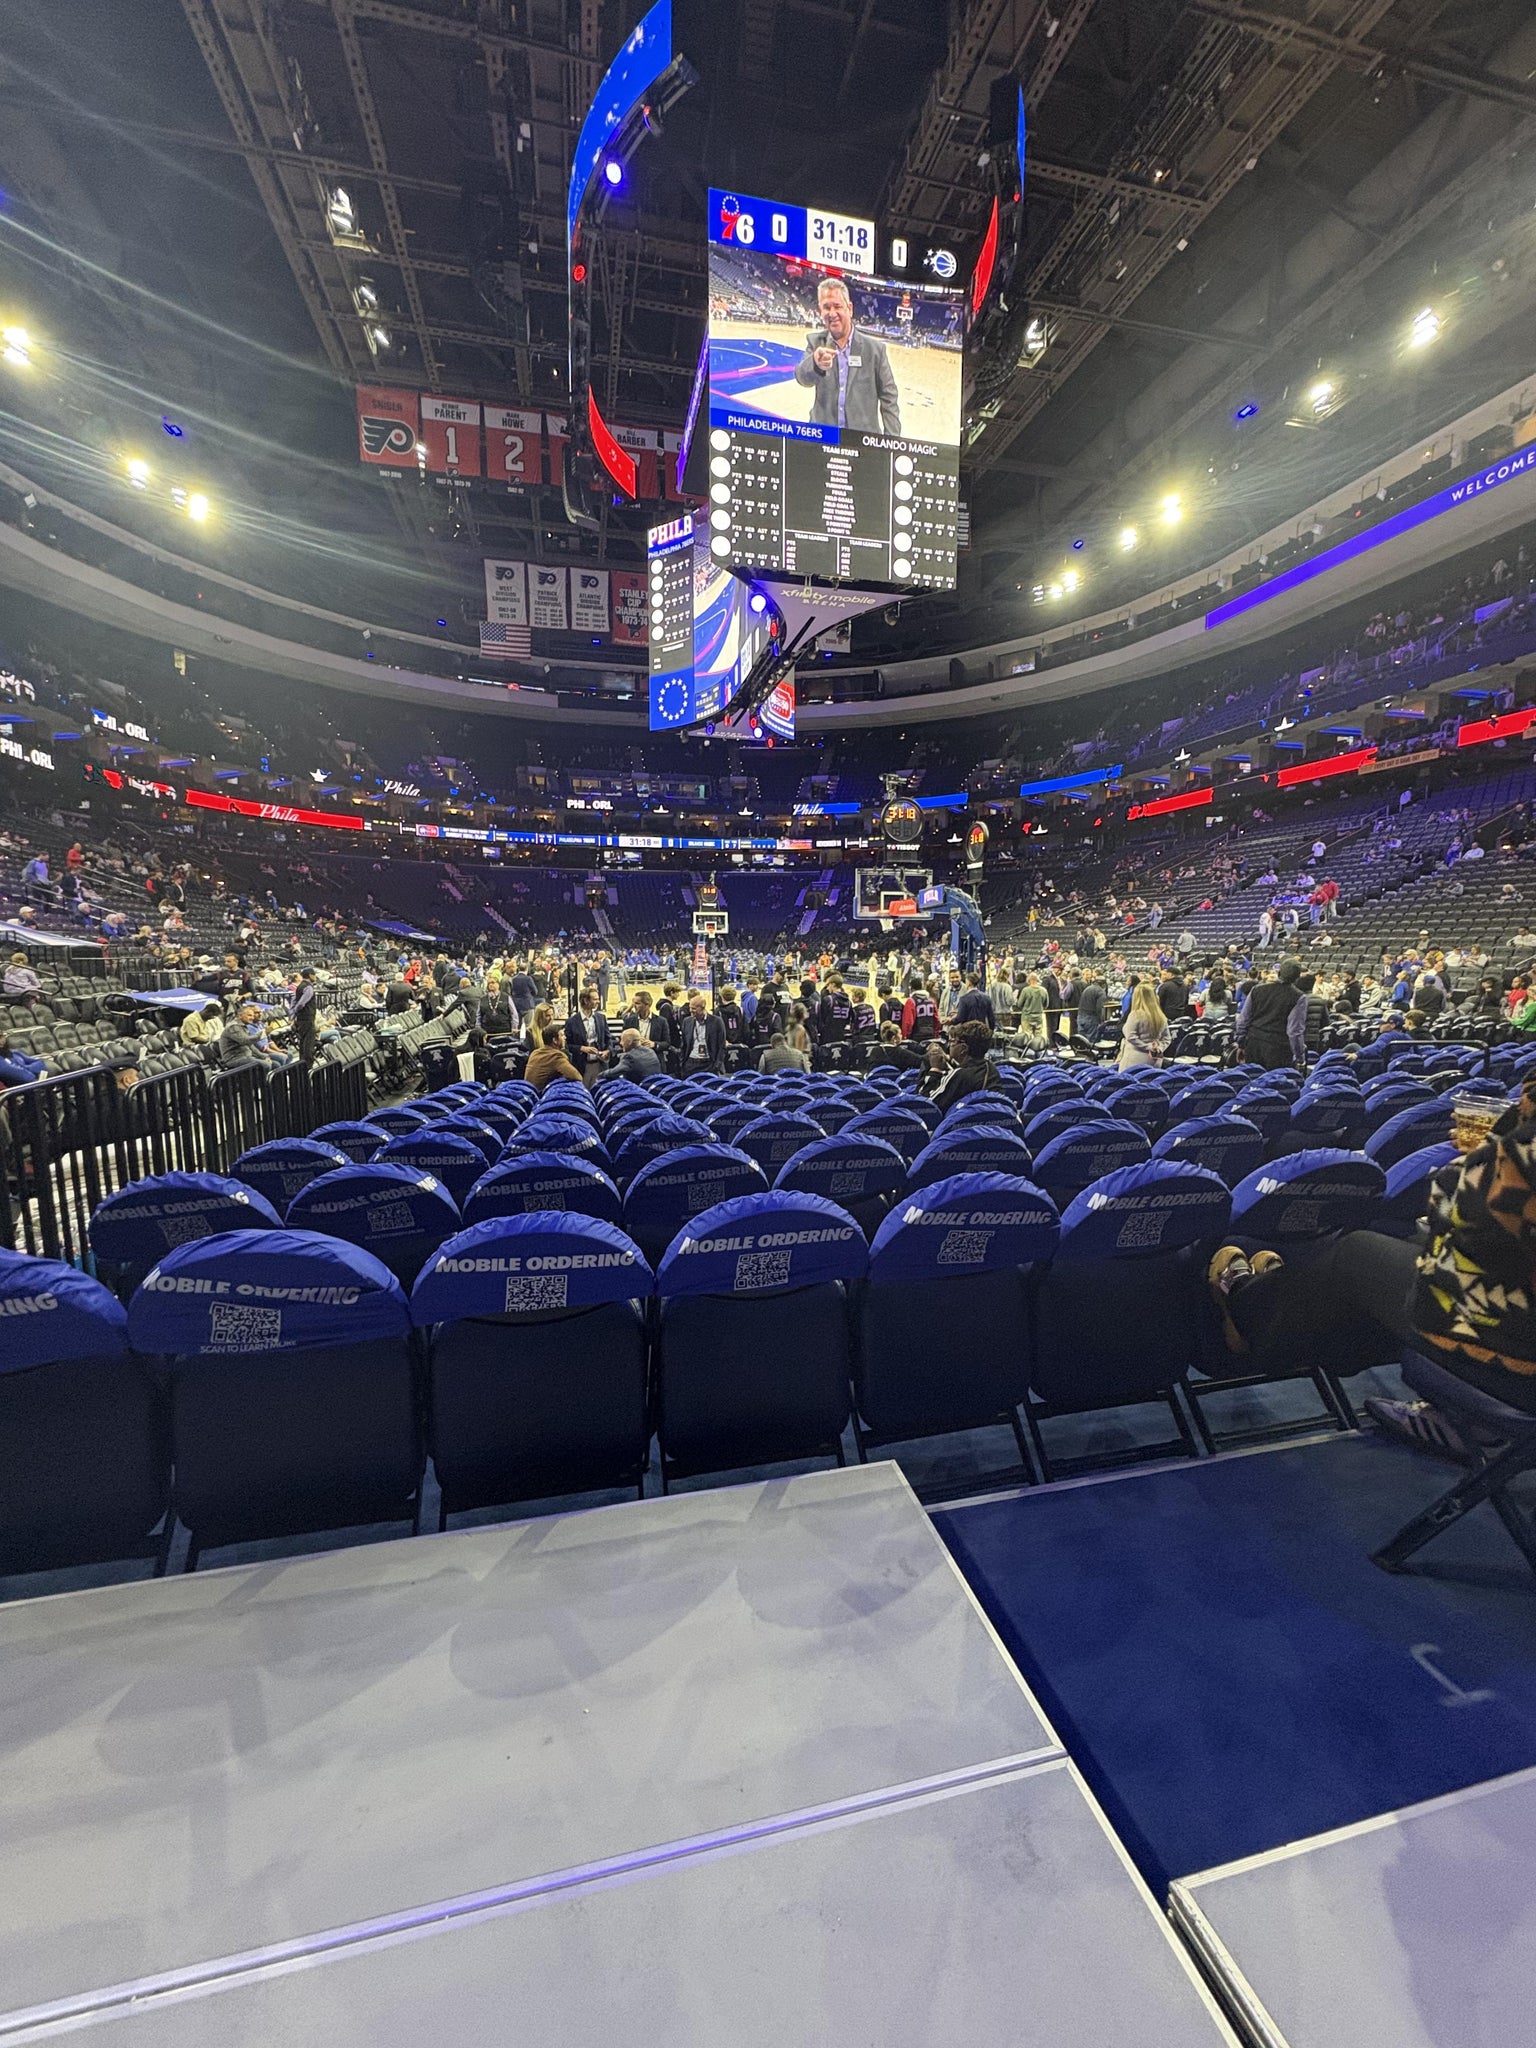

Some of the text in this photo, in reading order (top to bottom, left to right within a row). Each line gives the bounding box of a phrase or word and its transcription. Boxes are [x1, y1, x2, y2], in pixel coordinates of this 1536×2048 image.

[721, 208, 754, 244] 76
[772, 214, 787, 242] 0
[813, 218, 868, 249] 31:18
[820, 246, 861, 265] 1ST QTR
[892, 239, 908, 268] 0
[435, 408, 467, 421] PARENT
[502, 418, 525, 429] HOWE
[728, 415, 823, 439] PHILADELPHIA 76ERS
[446, 427, 459, 464] 1
[617, 435, 646, 447] BARBER
[823, 446, 859, 457] TEAM STATS
[862, 436, 938, 457] ORLANDO MAGIC
[504, 435, 524, 472] 2
[1451, 451, 1536, 502] WELCOME
[648, 515, 693, 548] PHILA
[627, 599, 642, 607] CUP
[802, 599, 846, 608] ARENA
[828, 594, 876, 605] mobile
[125, 722, 150, 742] ORL
[0, 738, 55, 770] PHI ORL
[566, 800, 613, 810] PHI ORL
[629, 838, 651, 846] 31:18
[858, 1013, 876, 1029] 22
[917, 1004, 935, 1017] 00
[240, 1160, 286, 1173] MOBILE
[374, 1153, 475, 1165] MOBILE ORDERING
[798, 1155, 903, 1171] MOBILE ORDERING
[937, 1152, 979, 1161] MOBILE
[645, 1160, 760, 1186] MOBILE ORDERING
[370, 1176, 438, 1201] ORDERING
[476, 1172, 605, 1197] MOBILE ORDERING
[97, 1191, 250, 1222] MOBILE ORDERING
[1086, 1191, 1226, 1210] MOBILE ORDERING
[902, 1205, 1052, 1226] MOBILE ORDERING
[679, 1226, 855, 1255] MOBILE ORDERING
[435, 1251, 636, 1273] MOBILE ORDERING
[143, 1267, 231, 1294] MOBILE
